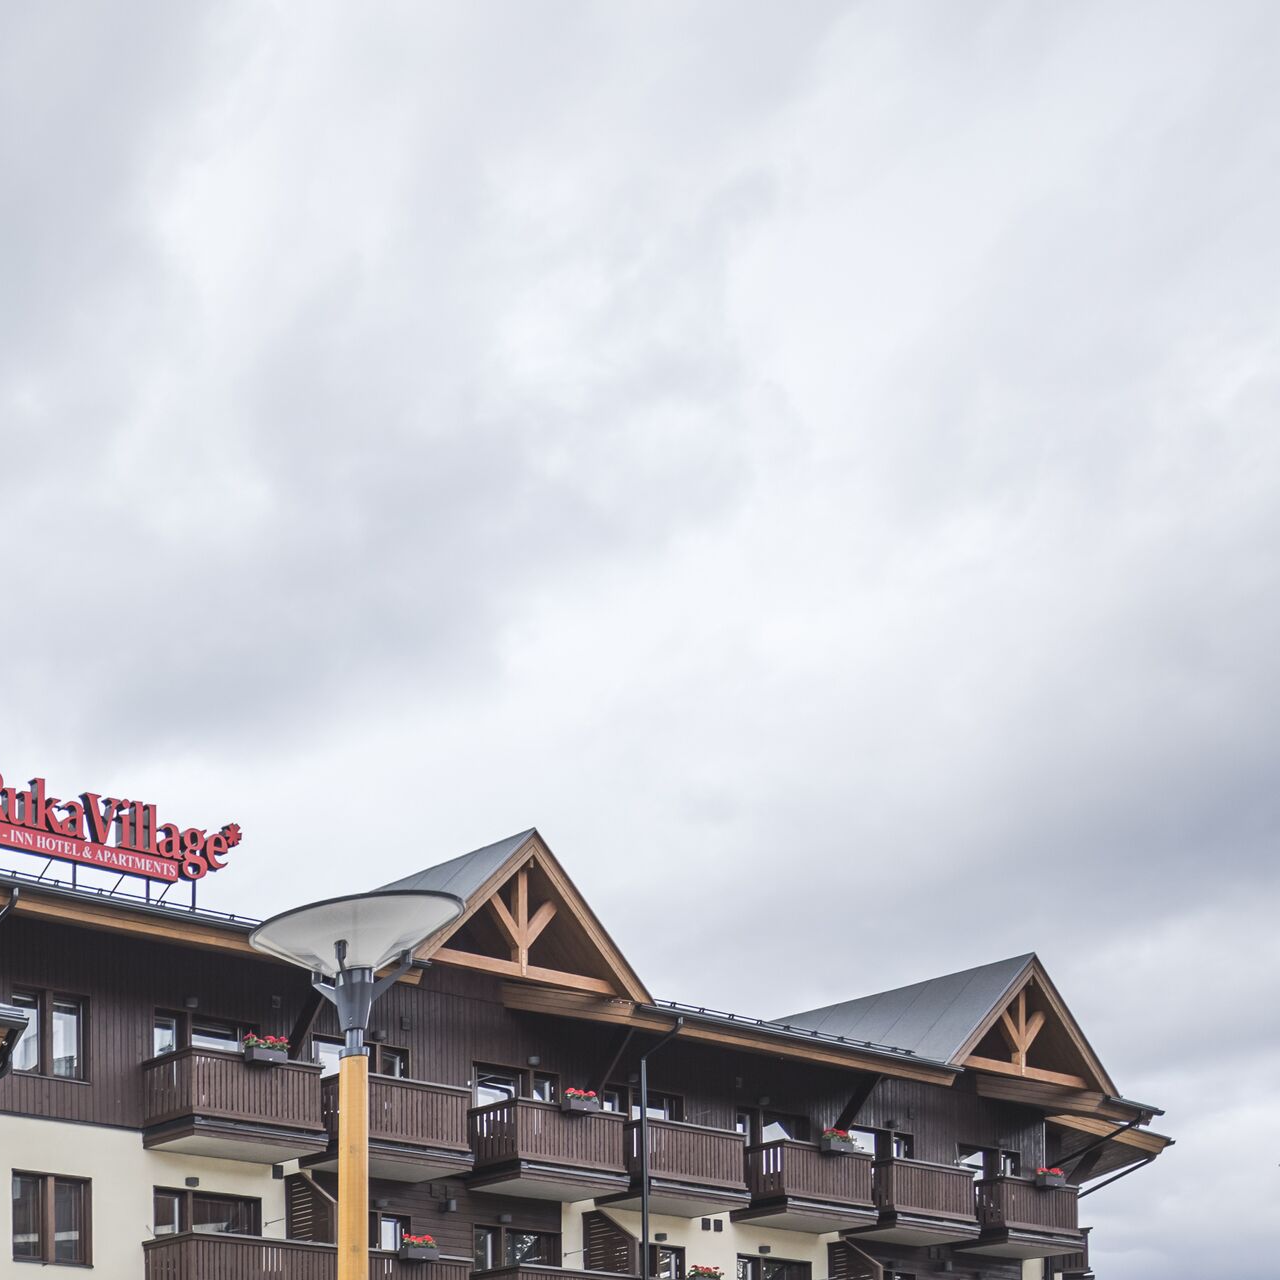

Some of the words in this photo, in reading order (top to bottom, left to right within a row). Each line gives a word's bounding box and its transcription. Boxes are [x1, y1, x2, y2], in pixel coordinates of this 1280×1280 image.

[10, 829, 33, 846] INN
[36, 836, 81, 856] HOTEL
[82, 846, 92, 859] &
[94, 849, 176, 877] APARTMENTS
